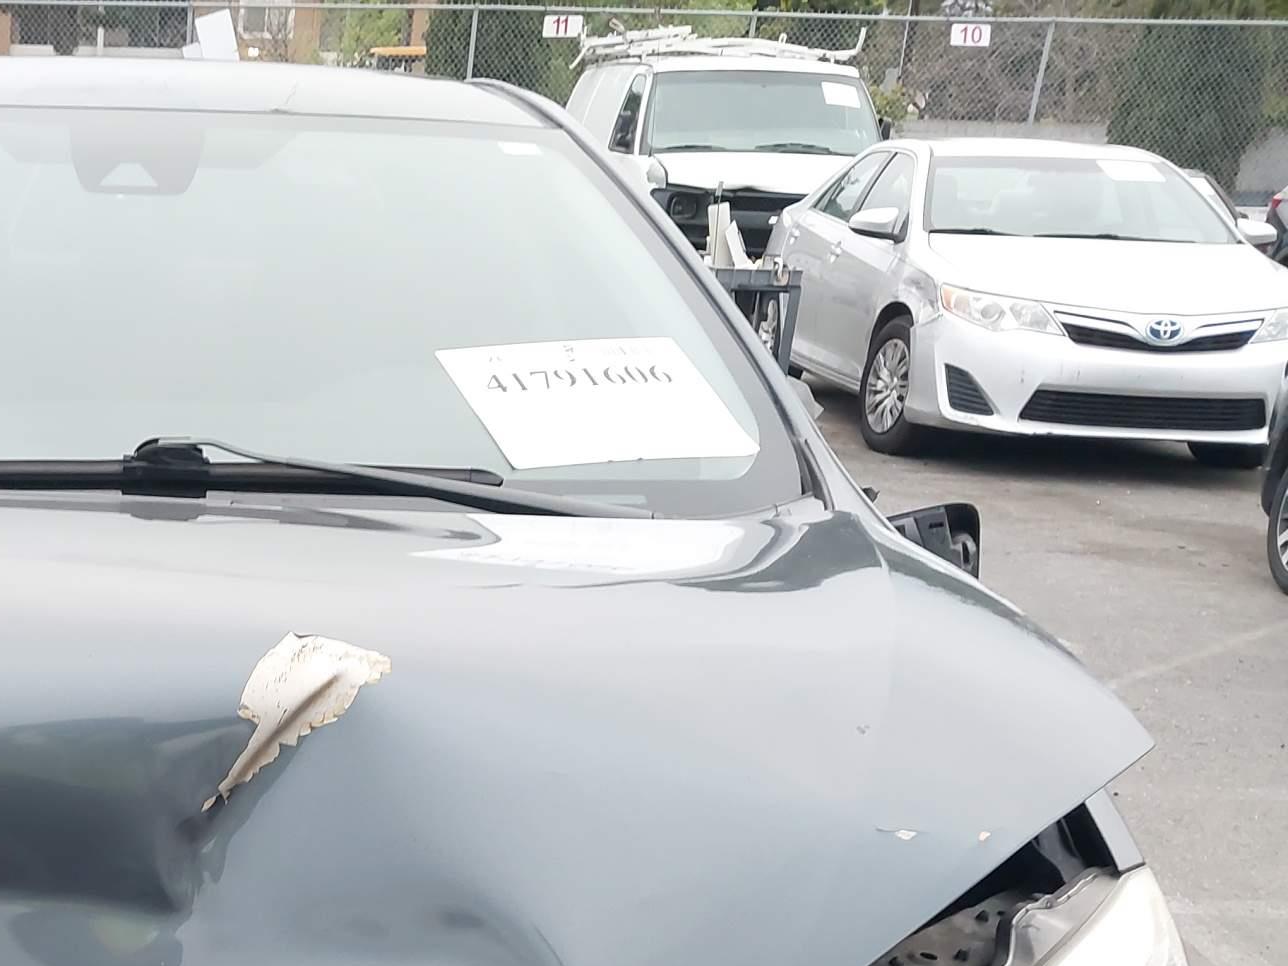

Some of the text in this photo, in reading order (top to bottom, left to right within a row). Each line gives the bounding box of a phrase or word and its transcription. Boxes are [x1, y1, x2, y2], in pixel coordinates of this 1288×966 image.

[552, 15, 569, 36] 11
[959, 25, 983, 44] 10
[486, 364, 673, 393] 41791606
